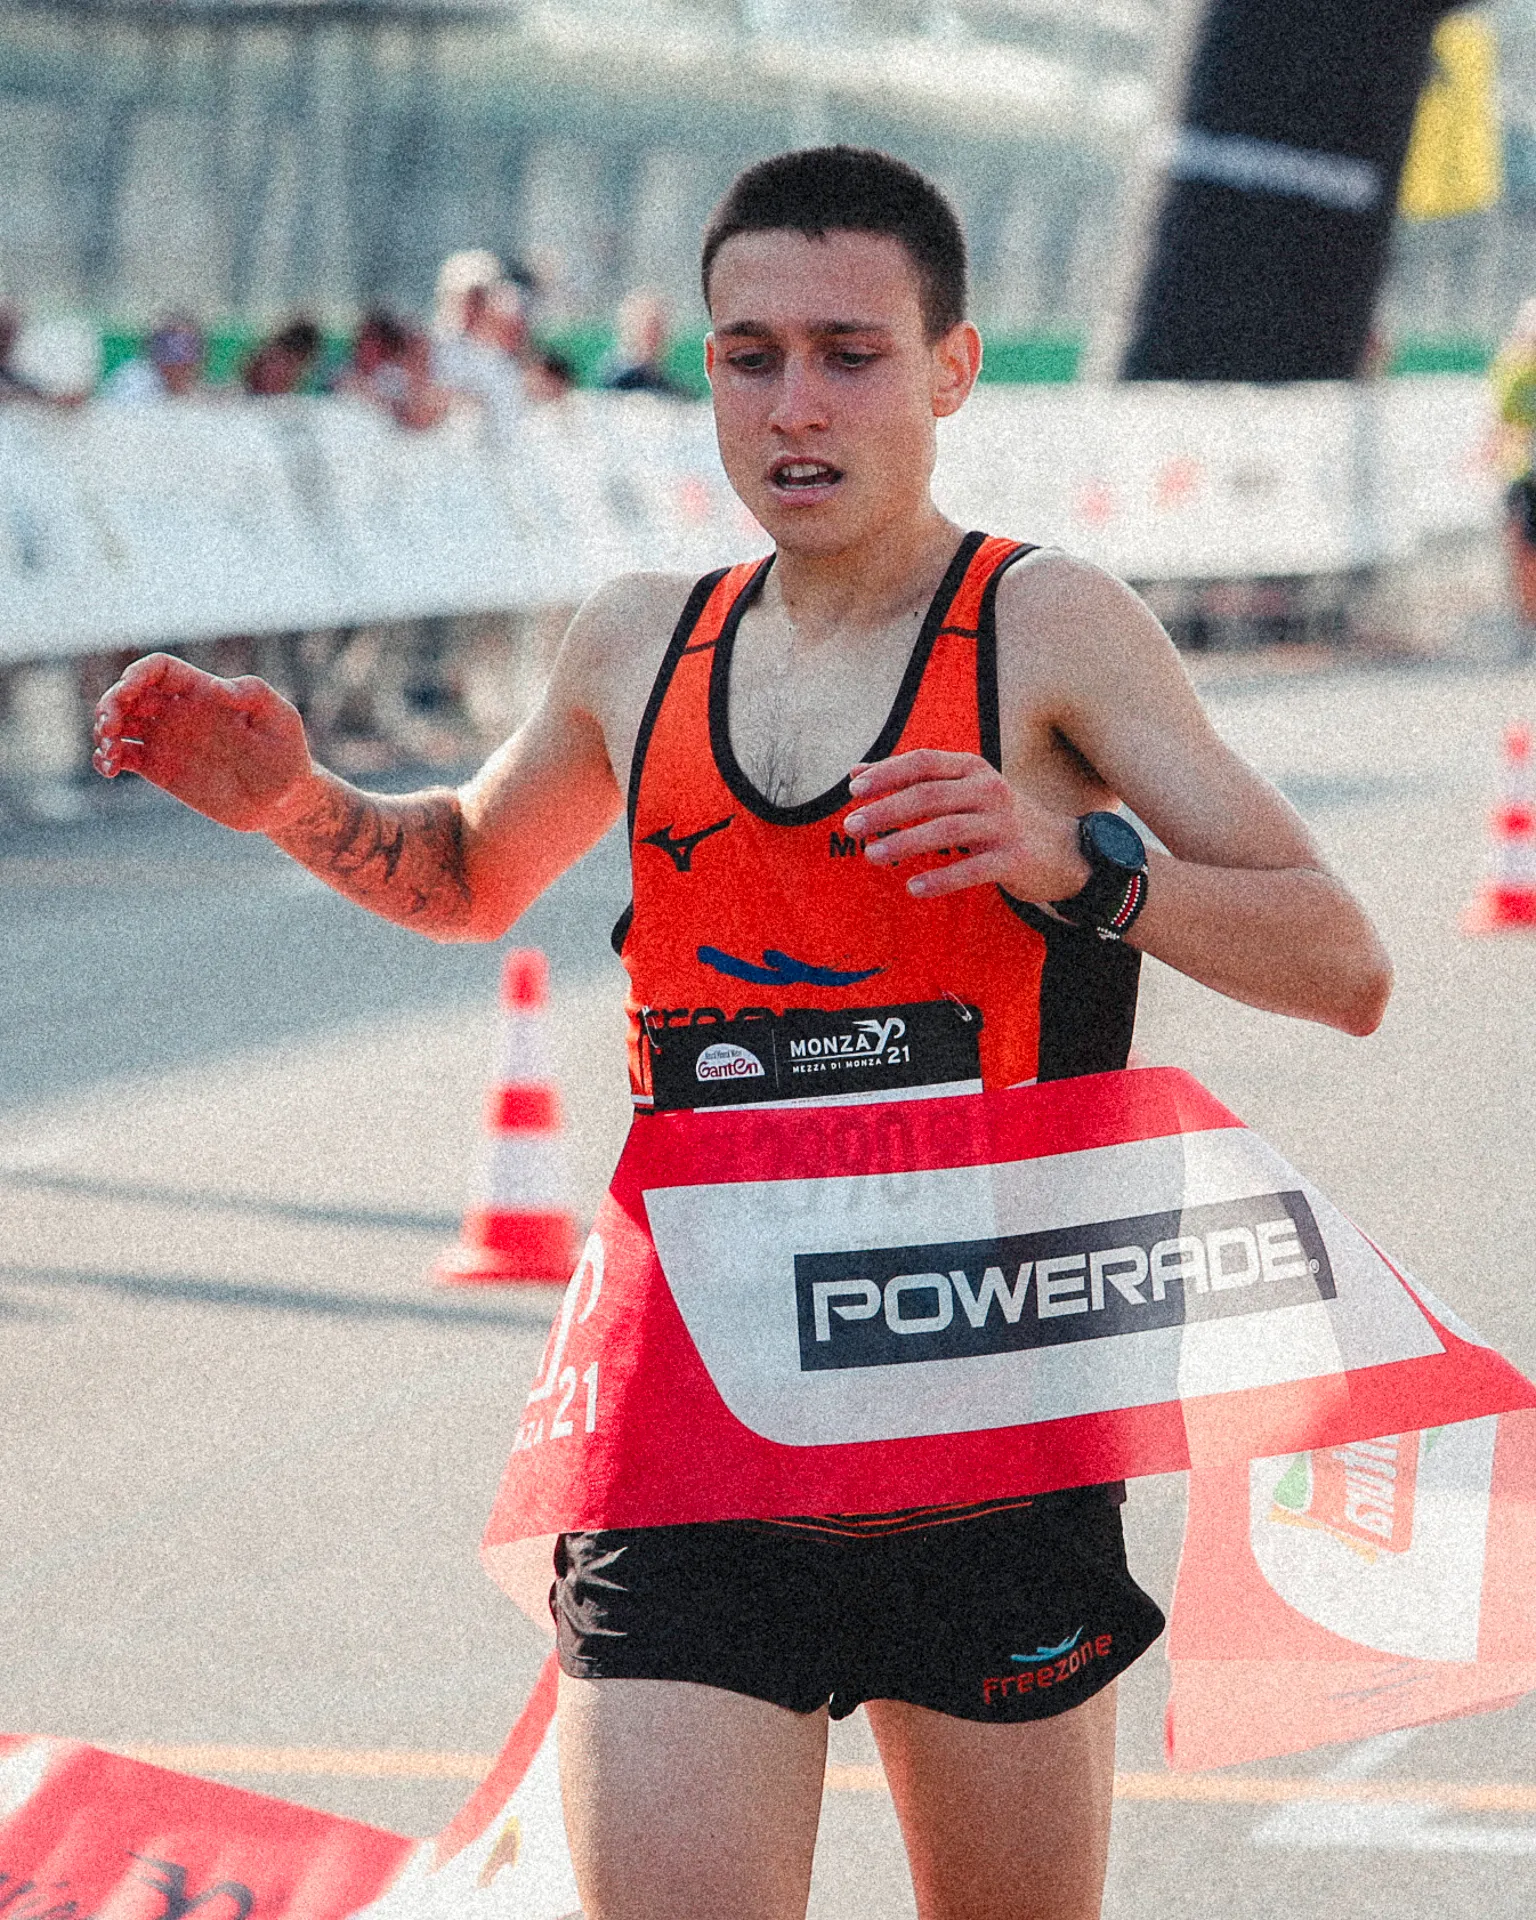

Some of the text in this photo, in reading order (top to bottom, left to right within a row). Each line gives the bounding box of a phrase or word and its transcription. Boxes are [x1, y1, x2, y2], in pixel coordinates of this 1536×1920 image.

[789, 1033, 910, 1064] MONZA 21
[792, 1058, 882, 1074] MEZZA DI MONZA
[812, 1217, 1309, 1342] POWERADE
[550, 1361, 599, 1440] 21
